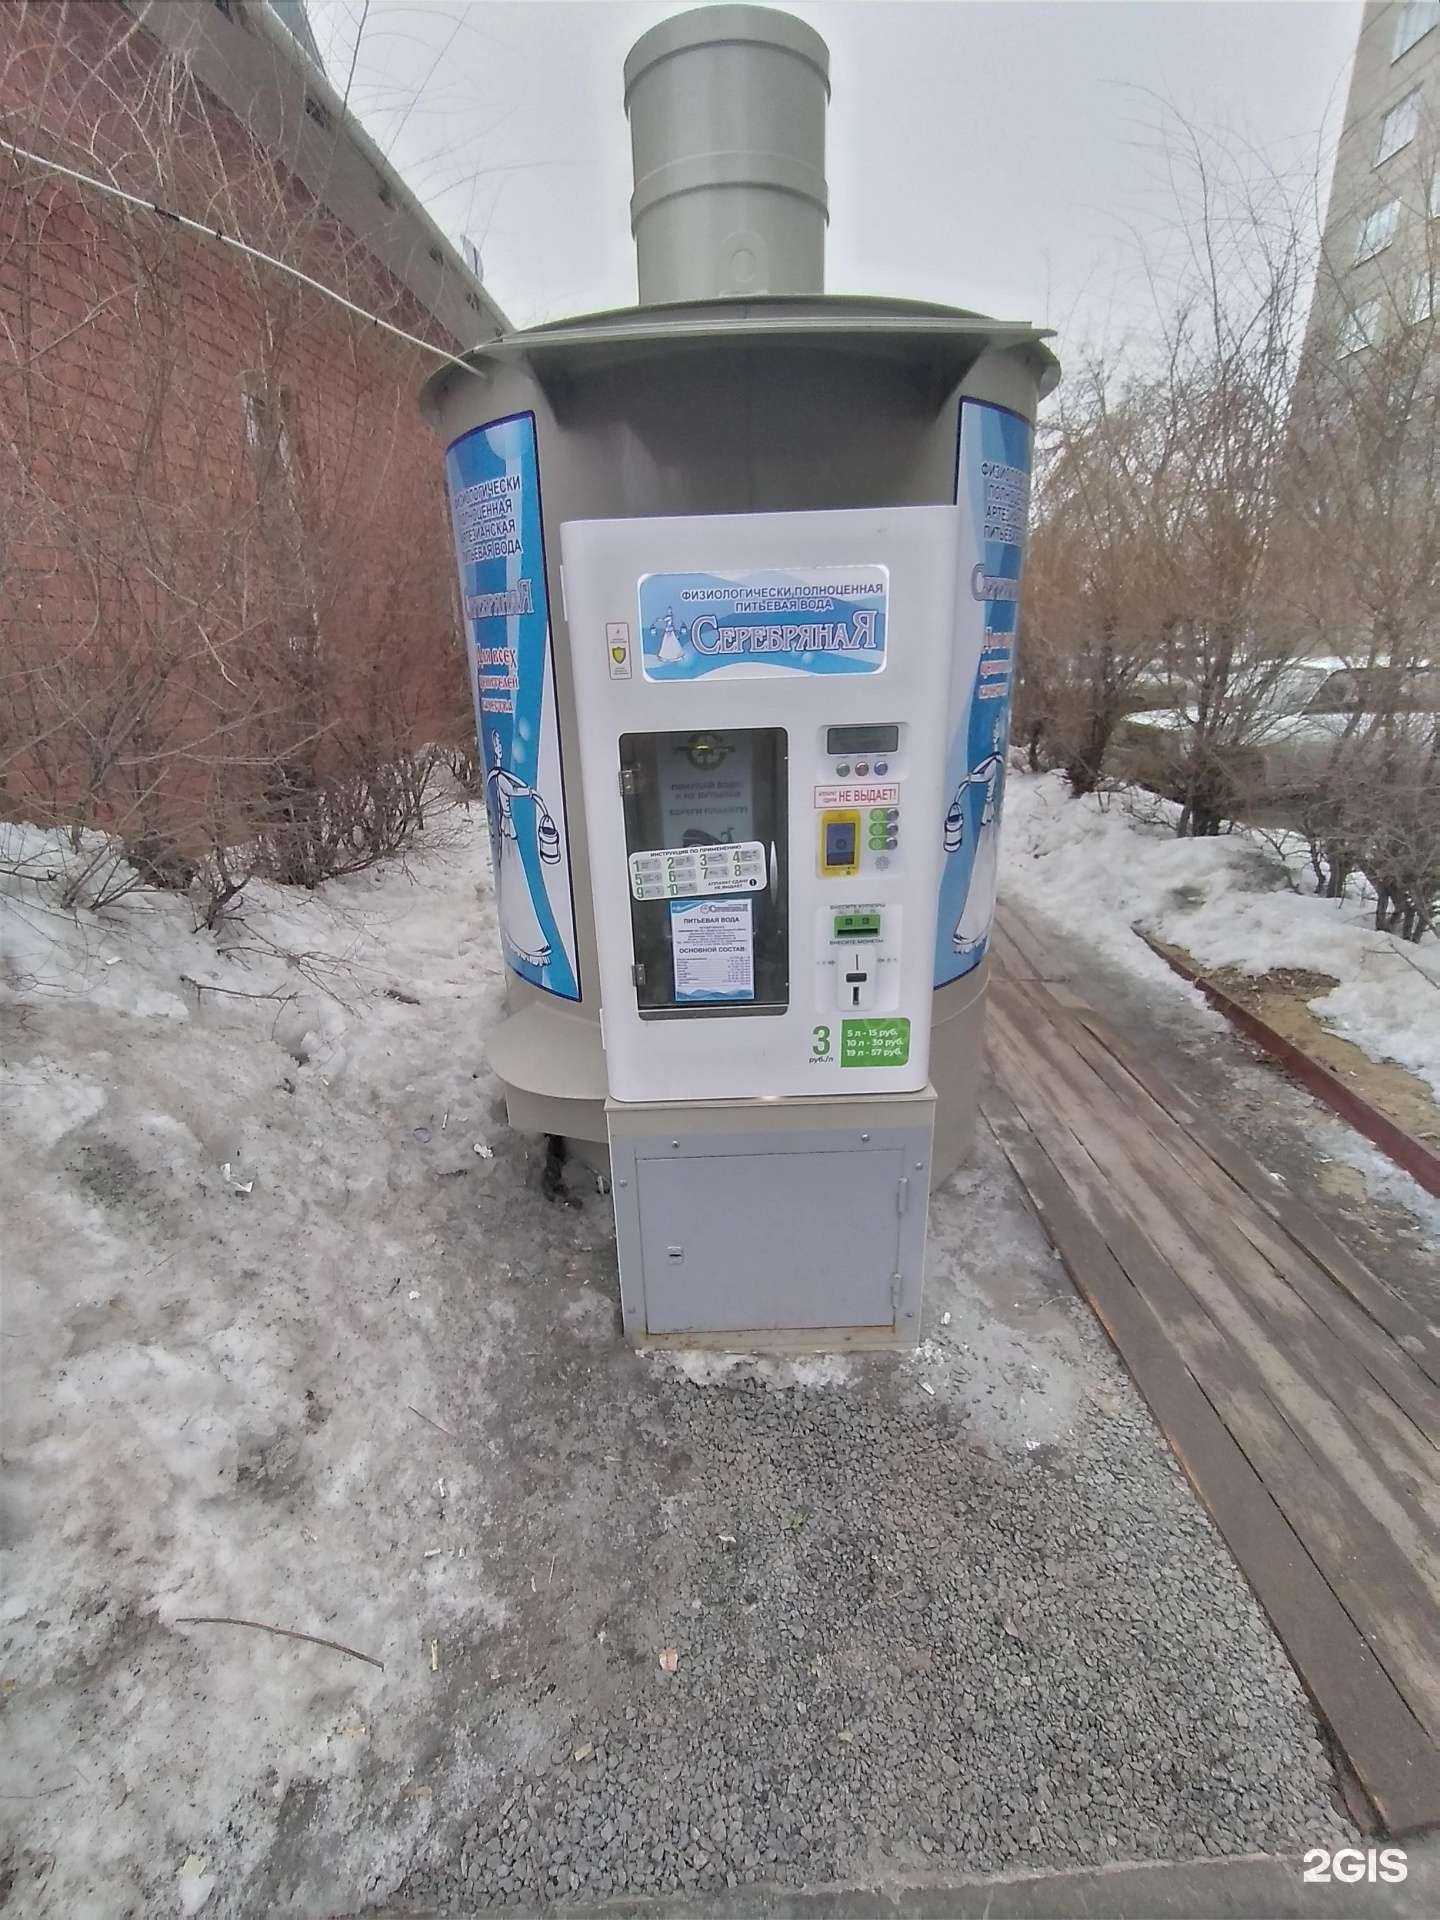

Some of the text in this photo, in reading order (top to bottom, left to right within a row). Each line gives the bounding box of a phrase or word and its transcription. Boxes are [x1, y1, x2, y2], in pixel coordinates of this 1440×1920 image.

[494, 539, 523, 557] ВОДА
[681, 583, 884, 601] ФИЗИОЛОГИЧЕСКИ ПОЛНОЦЕННАЯ
[735, 599, 833, 613] ПИТЬЕВАЯ ВОДА
[838, 791, 851, 802] НЕ
[854, 789, 896, 802] ВЫДАЕТ!
[667, 857, 675, 869] 2
[700, 854, 707, 867] 3
[733, 851, 740, 863] 4
[633, 860, 640, 872] 1
[734, 864, 741, 877] 8
[668, 871, 676, 883] 6
[701, 867, 708, 879] 7
[634, 873, 642, 886] 5
[636, 887, 644, 899] 9
[668, 884, 678, 896] 10
[679, 946, 717, 954] ОСНОВНОЙ
[880, 1028, 898, 1038] руб.
[812, 1025, 831, 1055] 3
[847, 1039, 857, 1047] 10
[858, 1039, 865, 1047] л
[872, 1038, 883, 1046] 30
[885, 1037, 904, 1048] руб.
[846, 1049, 856, 1057] 19
[857, 1049, 864, 1057] л
[871, 1048, 881, 1056] 57
[883, 1047, 902, 1057] руб.
